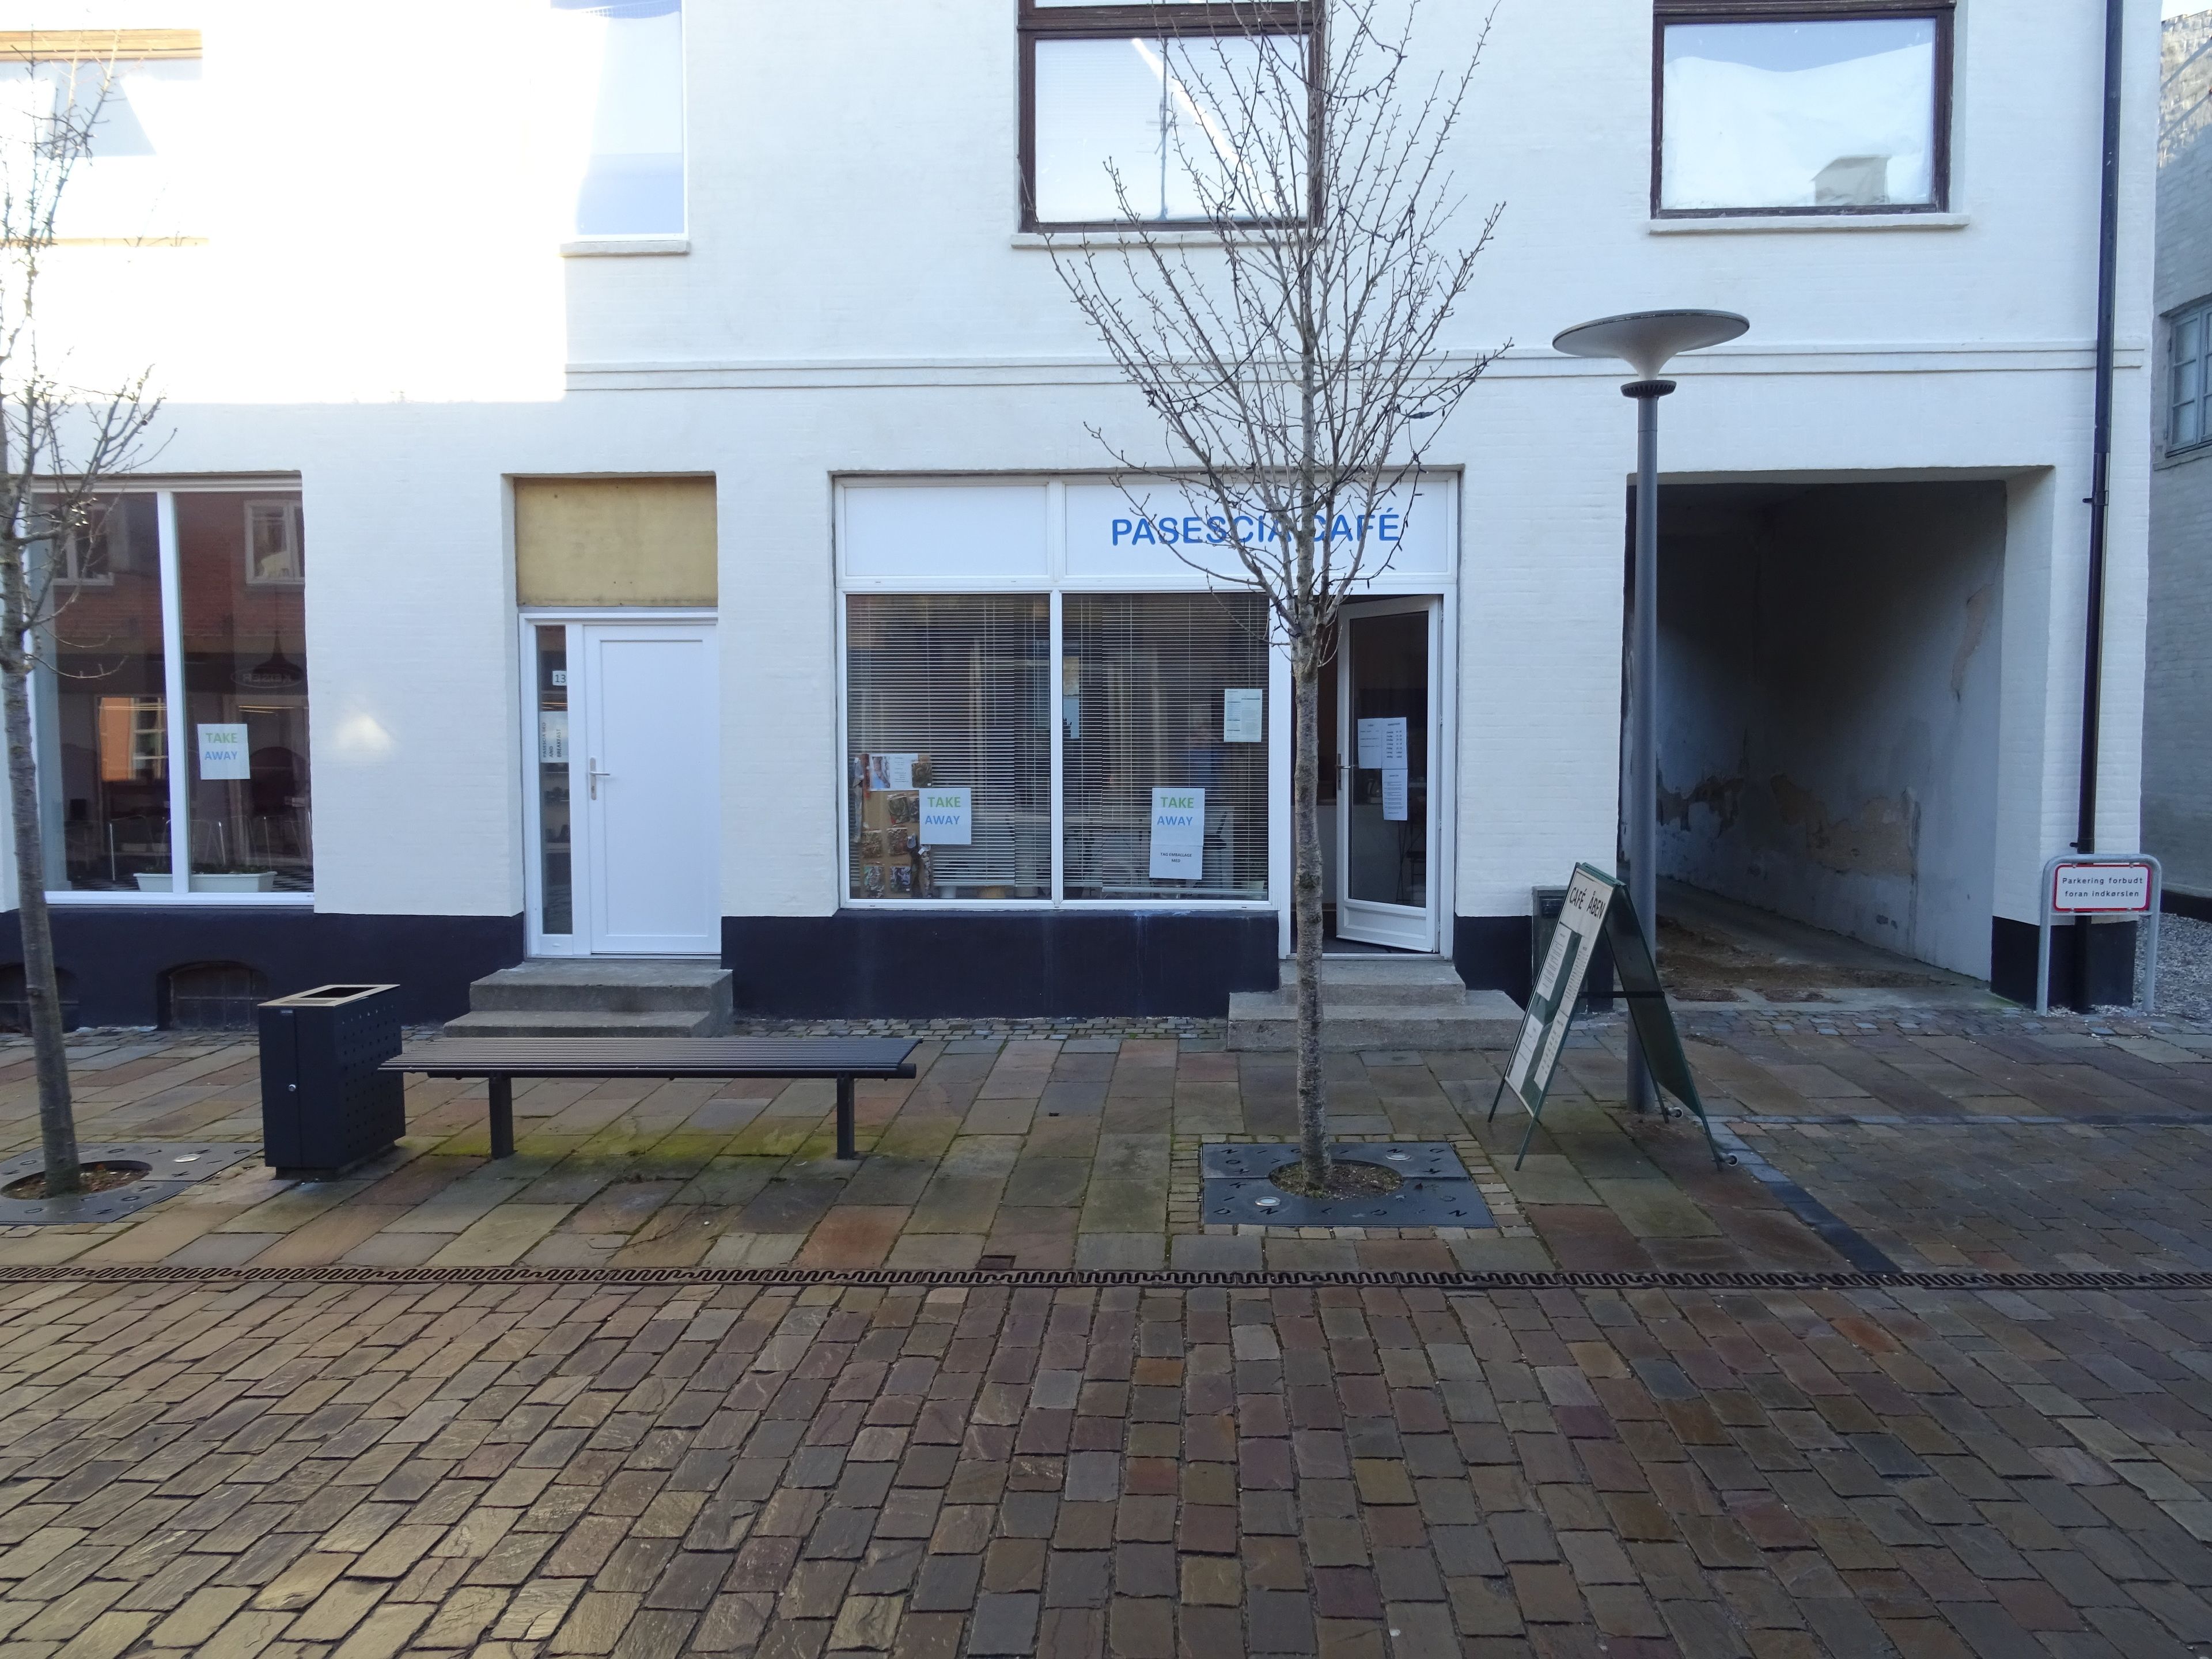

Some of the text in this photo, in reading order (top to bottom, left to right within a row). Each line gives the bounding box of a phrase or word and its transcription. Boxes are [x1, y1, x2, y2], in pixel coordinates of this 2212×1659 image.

[1112, 515, 1291, 546] PASESCIA
[555, 674, 566, 683] 13
[205, 732, 238, 744] TAKE
[204, 751, 238, 760] AWAY
[927, 797, 961, 808] TAKE
[1160, 797, 1194, 808] TAKE
[925, 815, 960, 825] AWAY
[1157, 816, 1193, 825] AWAY
[1569, 887, 1606, 920] CAFÉ ÅBEN
